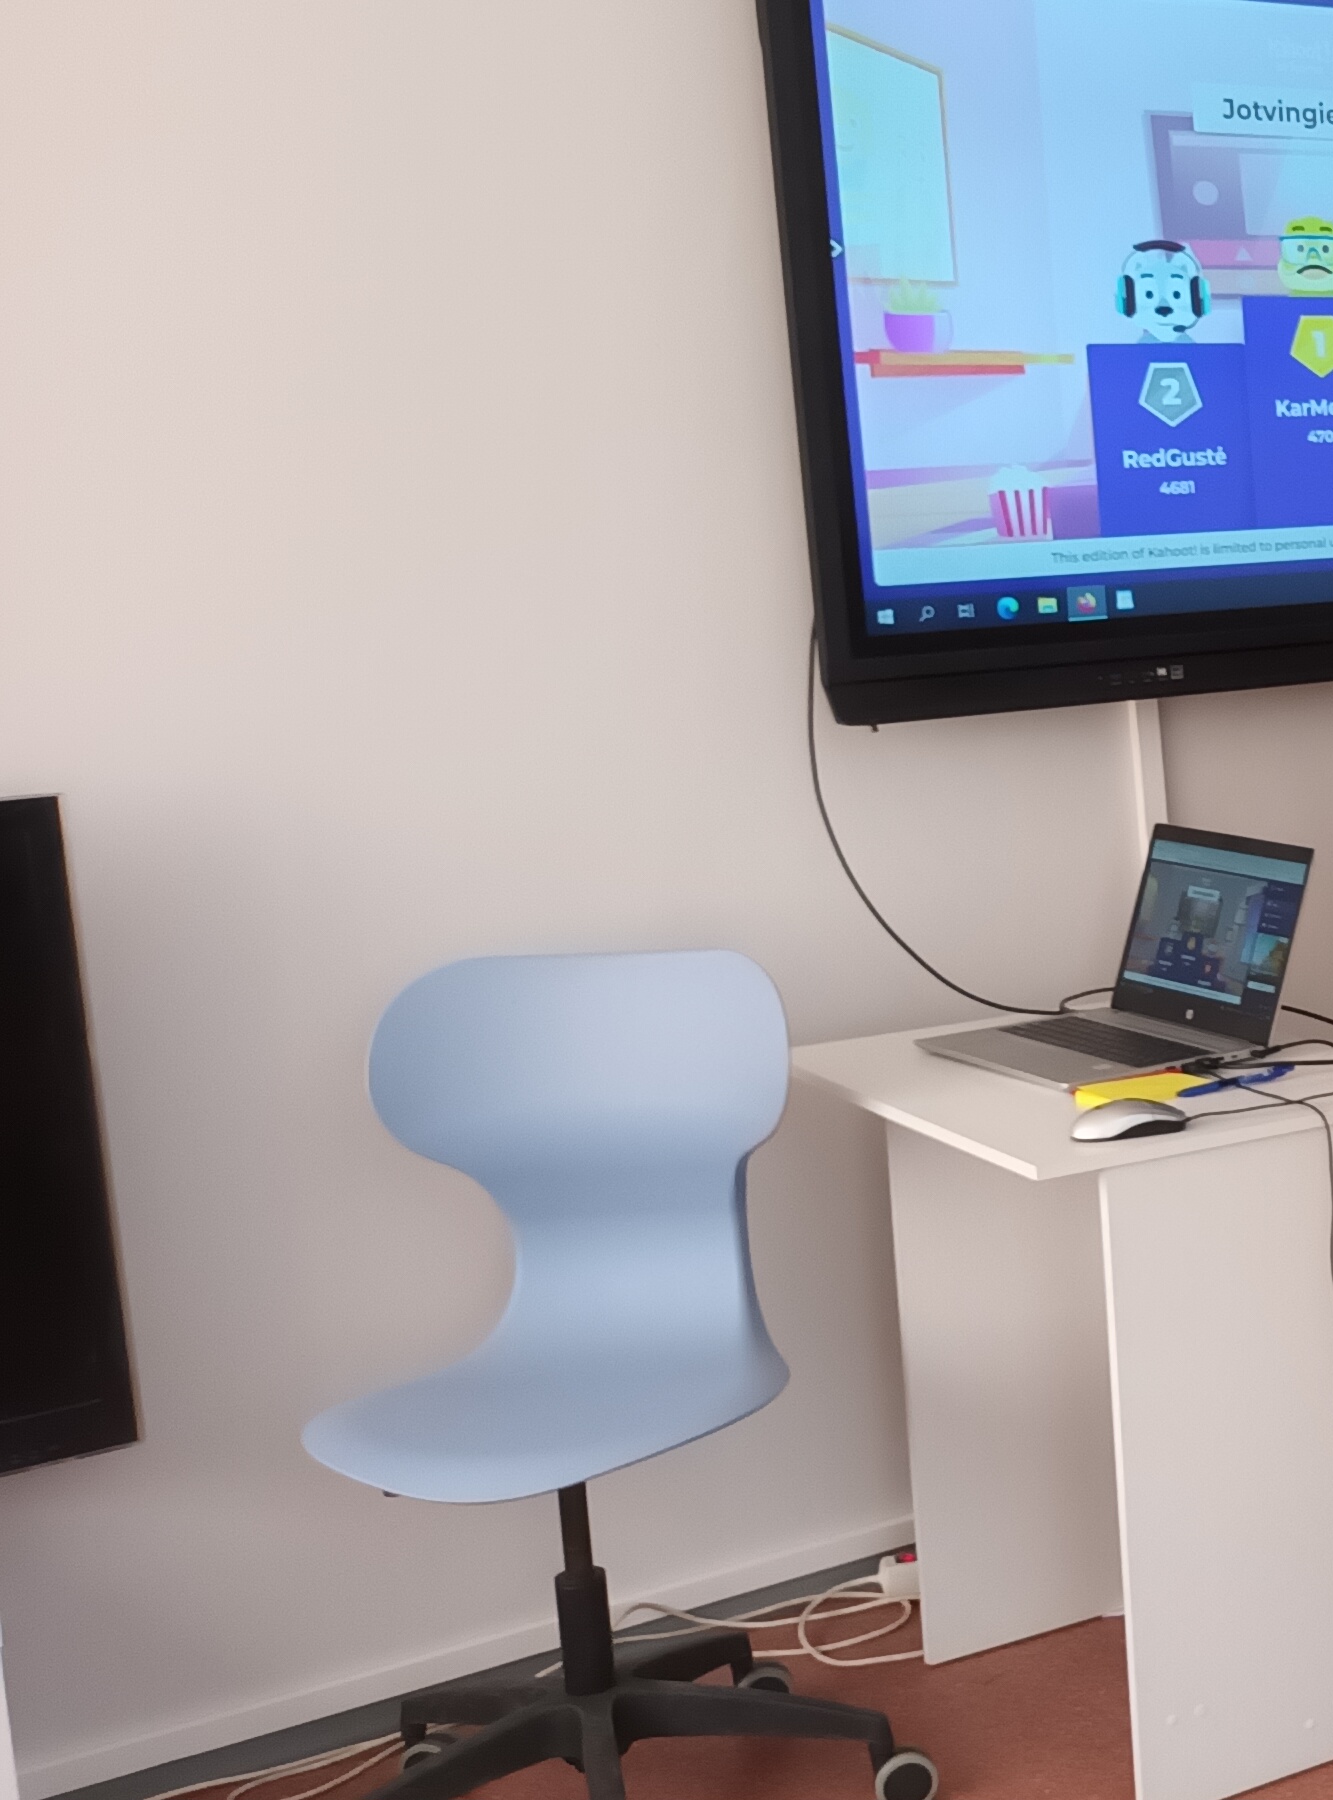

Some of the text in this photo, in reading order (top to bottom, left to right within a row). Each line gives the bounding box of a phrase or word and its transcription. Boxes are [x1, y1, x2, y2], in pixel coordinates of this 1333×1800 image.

[1311, 330, 1326, 358] 1
[1159, 377, 1182, 406] 2
[1122, 445, 1228, 469] RedGustė
[1051, 551, 1079, 564] This
[1082, 548, 1129, 563] edition
[1132, 547, 1146, 560] of
[1212, 541, 1256, 555] limited
[1274, 536, 1327, 553] personal
